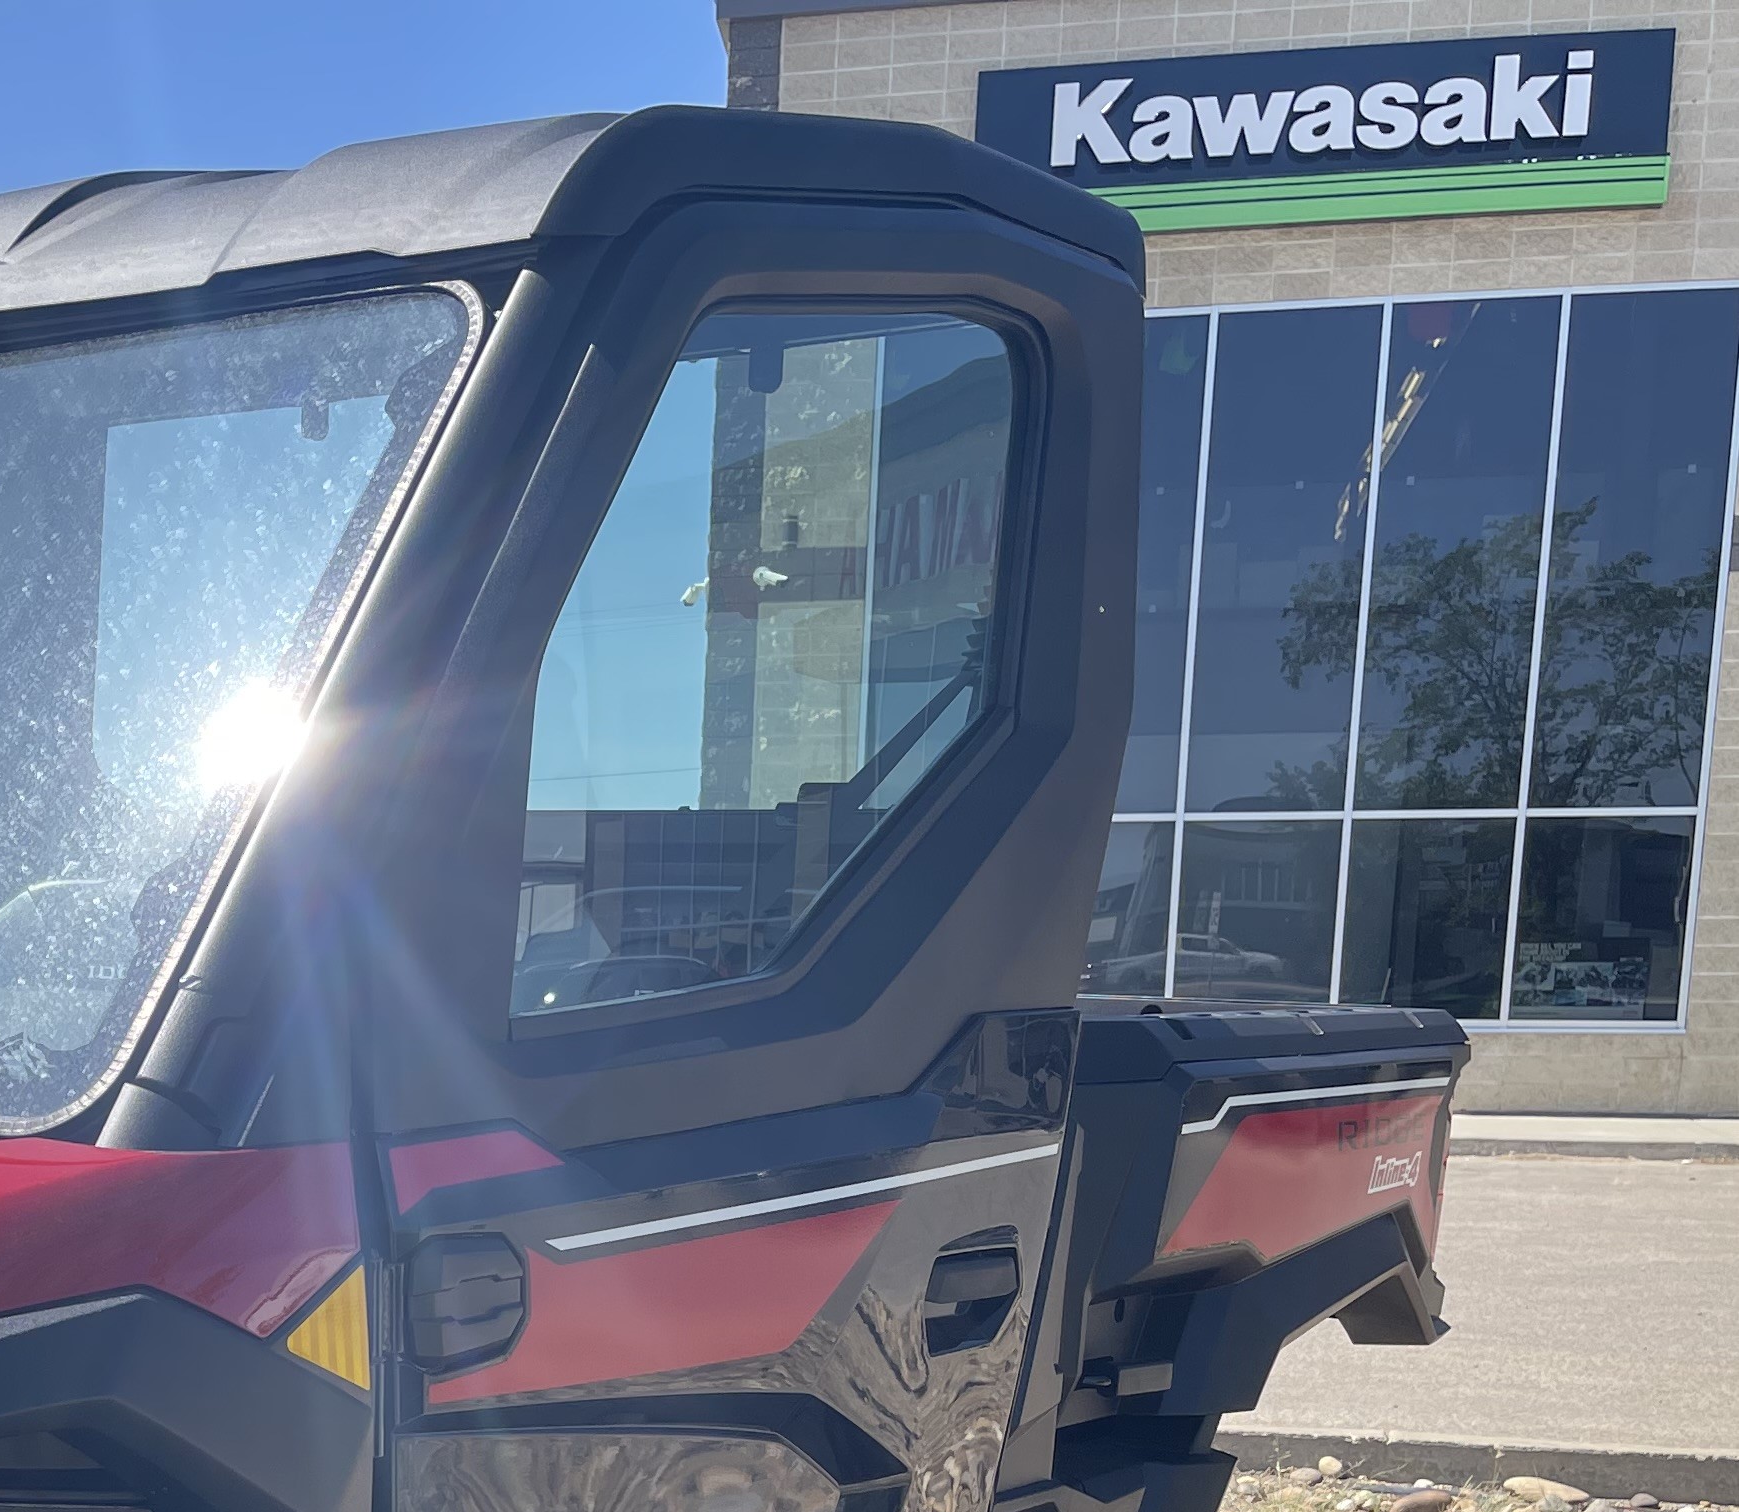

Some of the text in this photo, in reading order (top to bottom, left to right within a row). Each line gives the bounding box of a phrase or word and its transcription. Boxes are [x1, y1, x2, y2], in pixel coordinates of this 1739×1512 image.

[1050, 49, 1594, 168] Kawasaki
[1337, 1113, 1425, 1151] RIDGE
[1367, 1151, 1423, 1194] Inline-4
